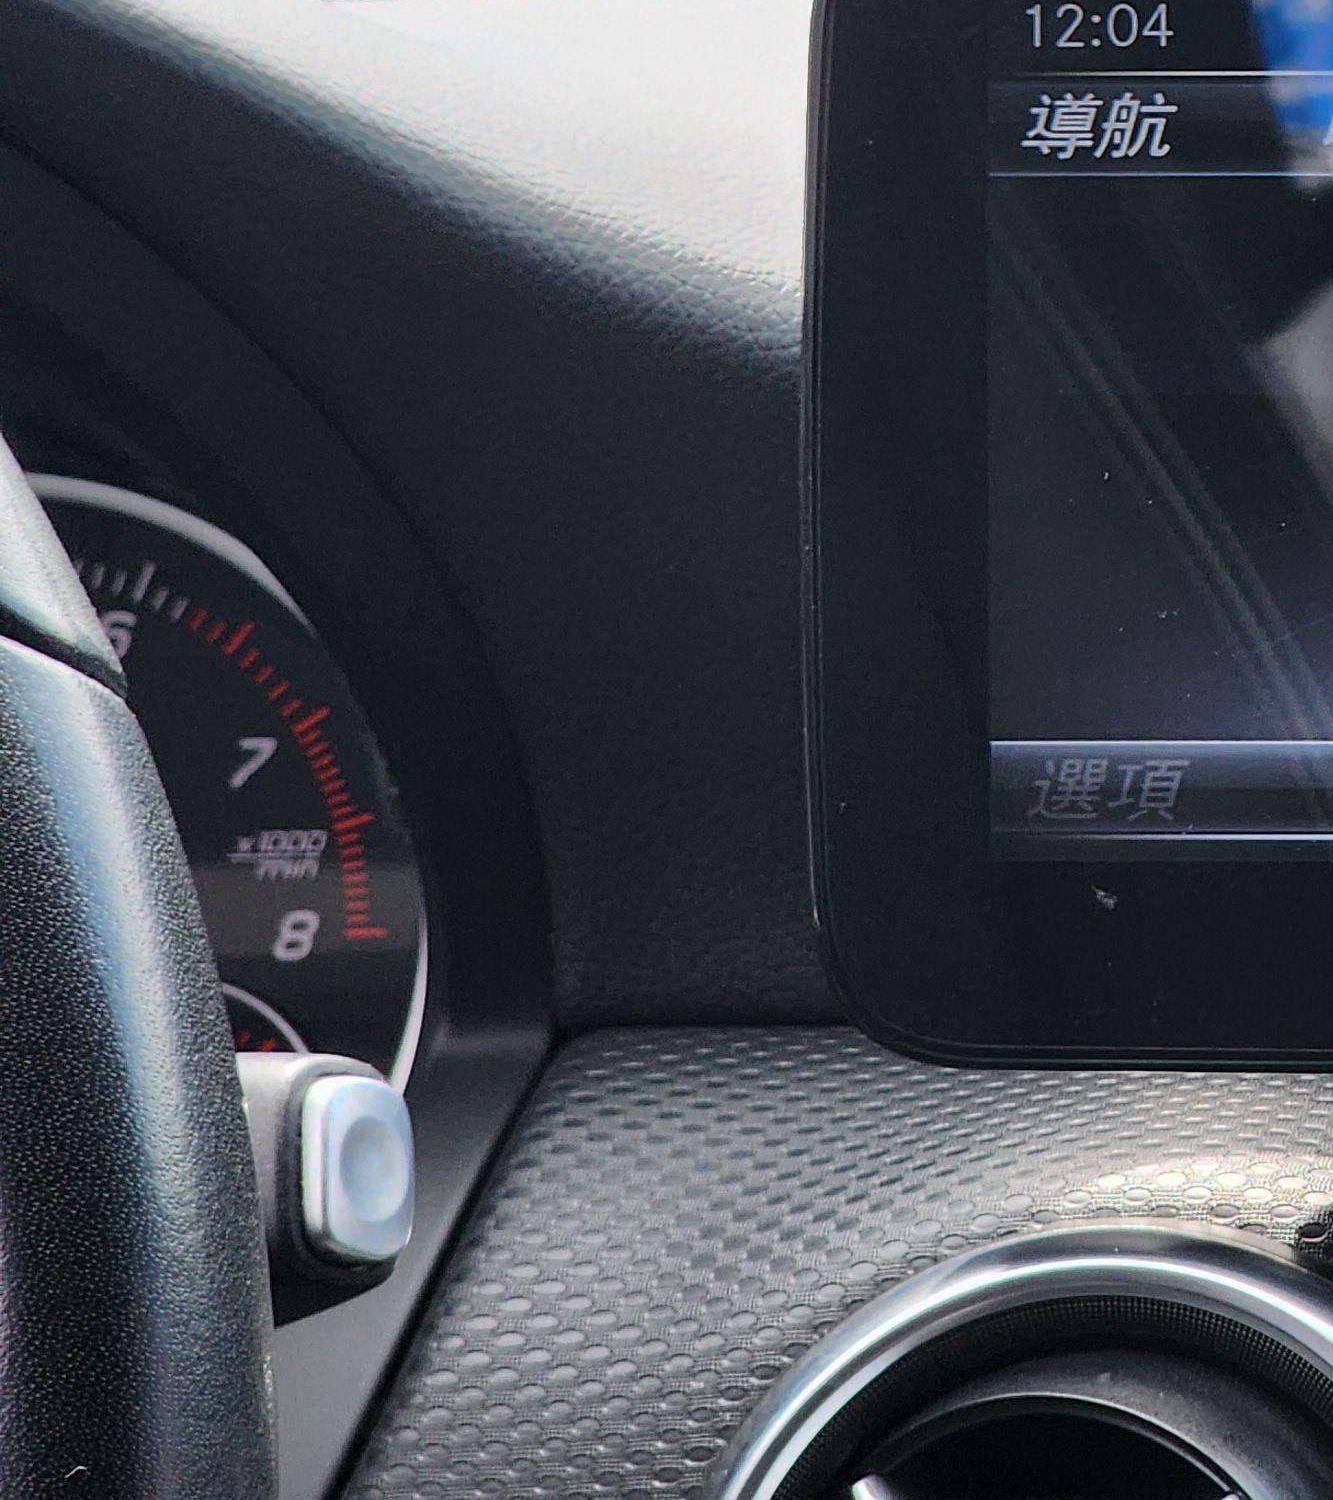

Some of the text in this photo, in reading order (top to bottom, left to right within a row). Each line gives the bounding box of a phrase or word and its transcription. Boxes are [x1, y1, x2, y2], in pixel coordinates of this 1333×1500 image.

[1024, 2, 1174, 49] 12:04
[1020, 91, 1178, 159] 導航
[228, 736, 278, 788] 7
[1027, 758, 1191, 821] 選項
[273, 909, 320, 961] 8
